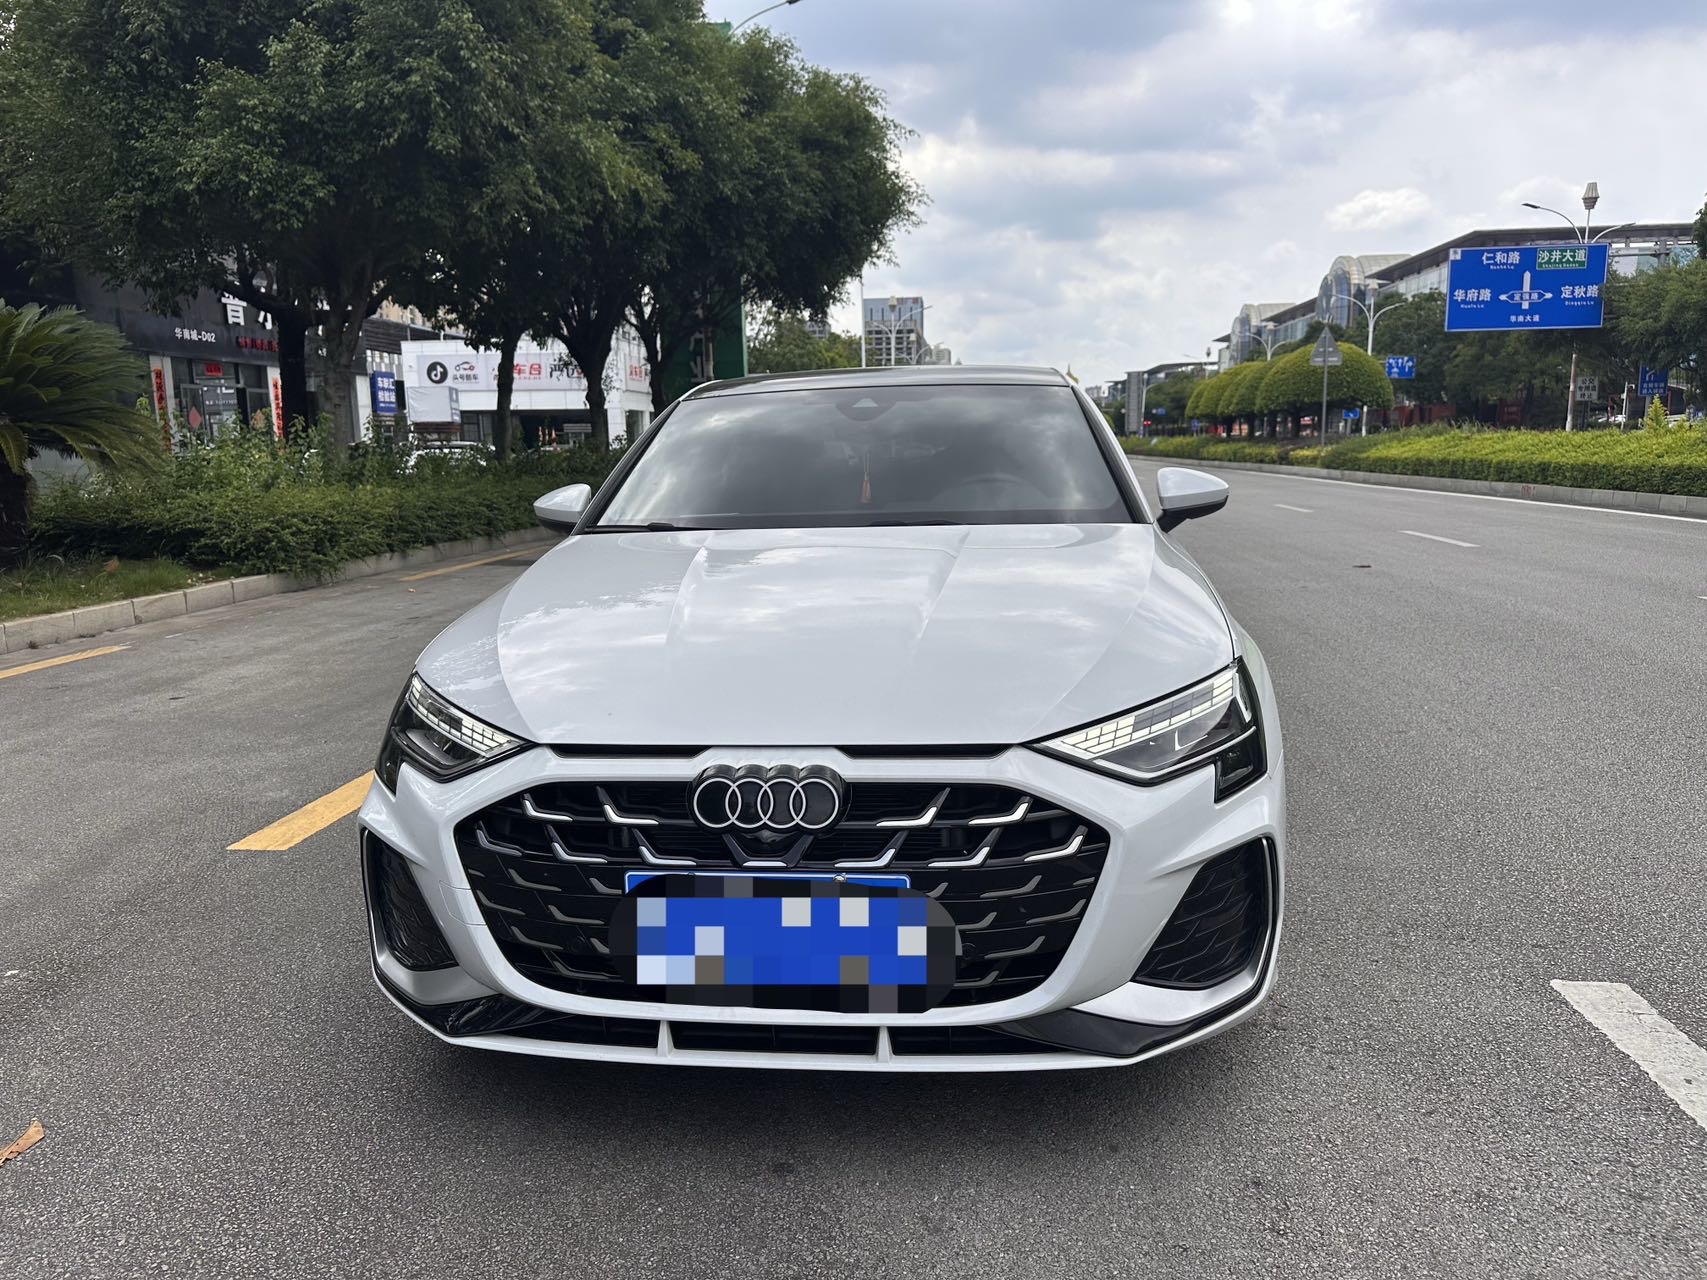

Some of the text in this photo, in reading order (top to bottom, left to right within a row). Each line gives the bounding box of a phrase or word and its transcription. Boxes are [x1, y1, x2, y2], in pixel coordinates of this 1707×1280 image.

[1482, 251, 1521, 265] 仁和路
[1538, 248, 1587, 263] 沙井大道
[1453, 288, 1492, 302] 华府路
[1561, 285, 1599, 299] 定秋路
